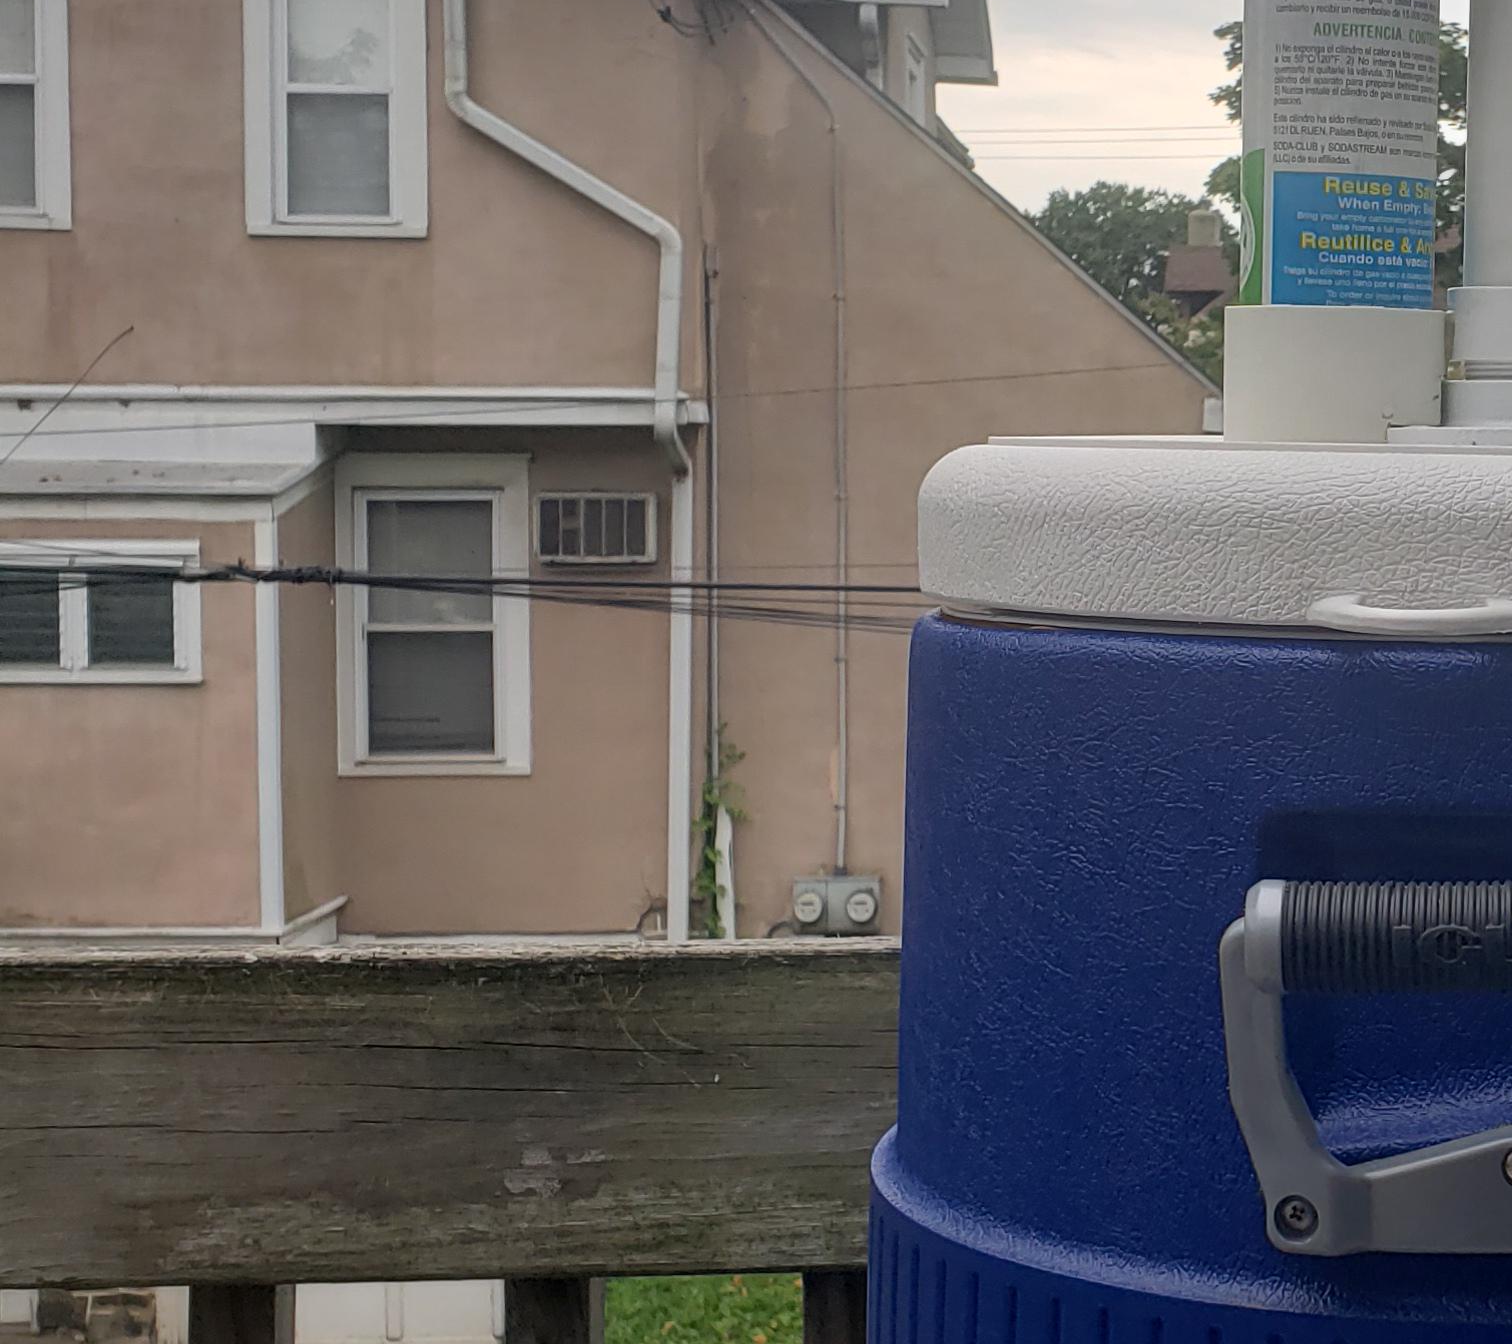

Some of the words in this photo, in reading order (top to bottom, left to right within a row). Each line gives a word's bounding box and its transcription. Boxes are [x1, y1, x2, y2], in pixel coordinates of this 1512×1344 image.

[1313, 22, 1402, 41] ADVERTENCIA
[1328, 143, 1387, 154] SODASTREAM
[1324, 176, 1392, 196] Reuse
[1399, 181, 1410, 198] &
[1338, 197, 1379, 210] When
[1300, 231, 1395, 252] Reutilice
[1400, 237, 1411, 253] &
[1319, 252, 1373, 265] Cuando
[1378, 256, 1403, 266] está
